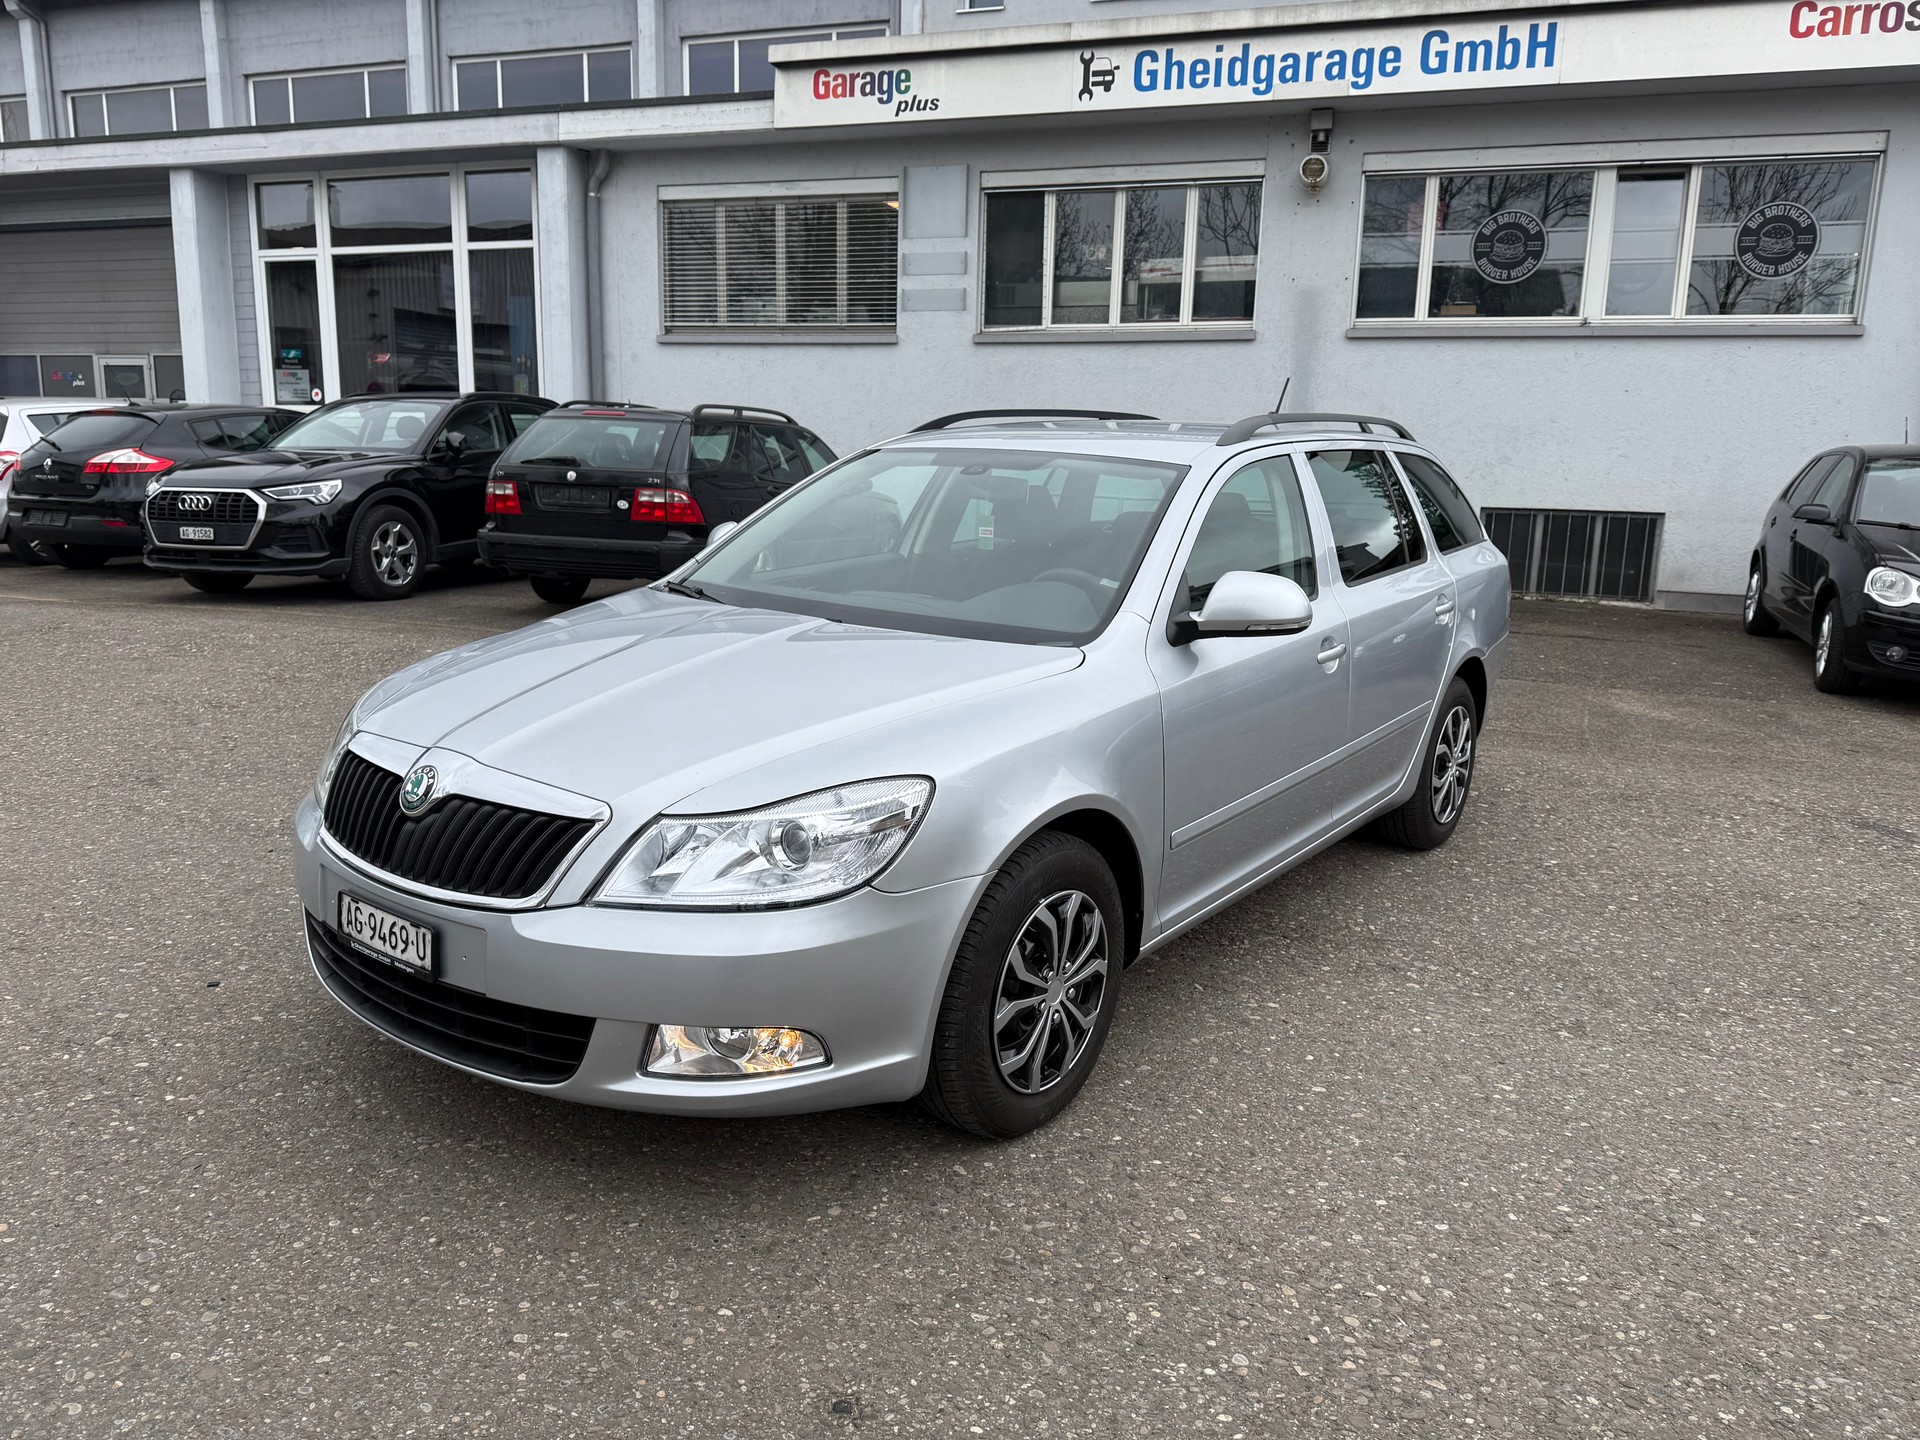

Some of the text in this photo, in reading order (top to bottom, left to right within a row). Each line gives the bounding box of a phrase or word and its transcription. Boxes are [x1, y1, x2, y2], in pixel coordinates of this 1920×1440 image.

[1133, 22, 1558, 96] Gheidgarage GmbH
[813, 68, 912, 105] Garage
[895, 95, 940, 117] plus
[1481, 212, 1540, 236] BIG BROTHERS
[1747, 205, 1812, 230] BIG BROTHERS
[1477, 256, 1538, 280] BURGER HOUSE
[1741, 250, 1809, 276] BURGER HOUSE
